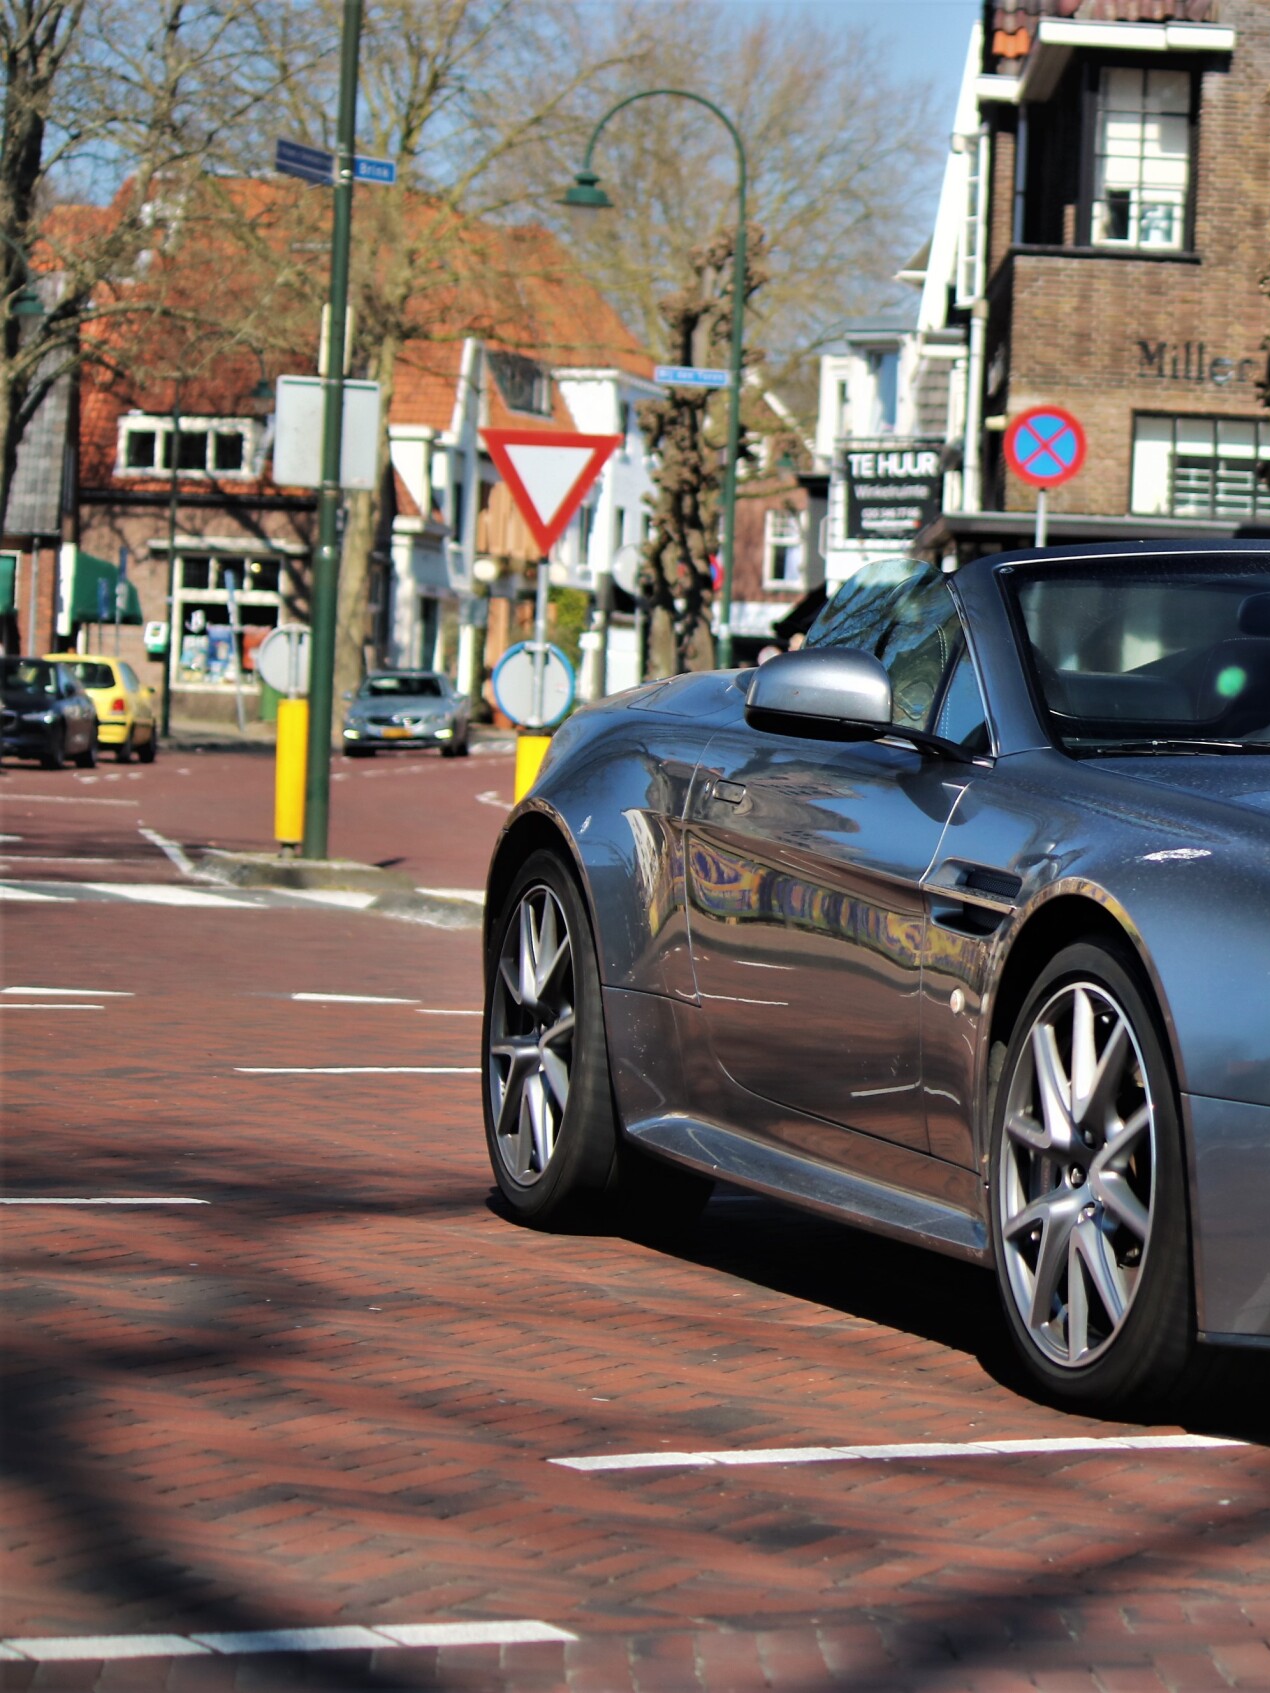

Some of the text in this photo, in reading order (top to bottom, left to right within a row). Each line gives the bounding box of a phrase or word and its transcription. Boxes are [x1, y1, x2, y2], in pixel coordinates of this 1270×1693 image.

[360, 161, 389, 179] Brink
[1137, 340, 1254, 387] Miller
[848, 451, 938, 478] TE HUUR
